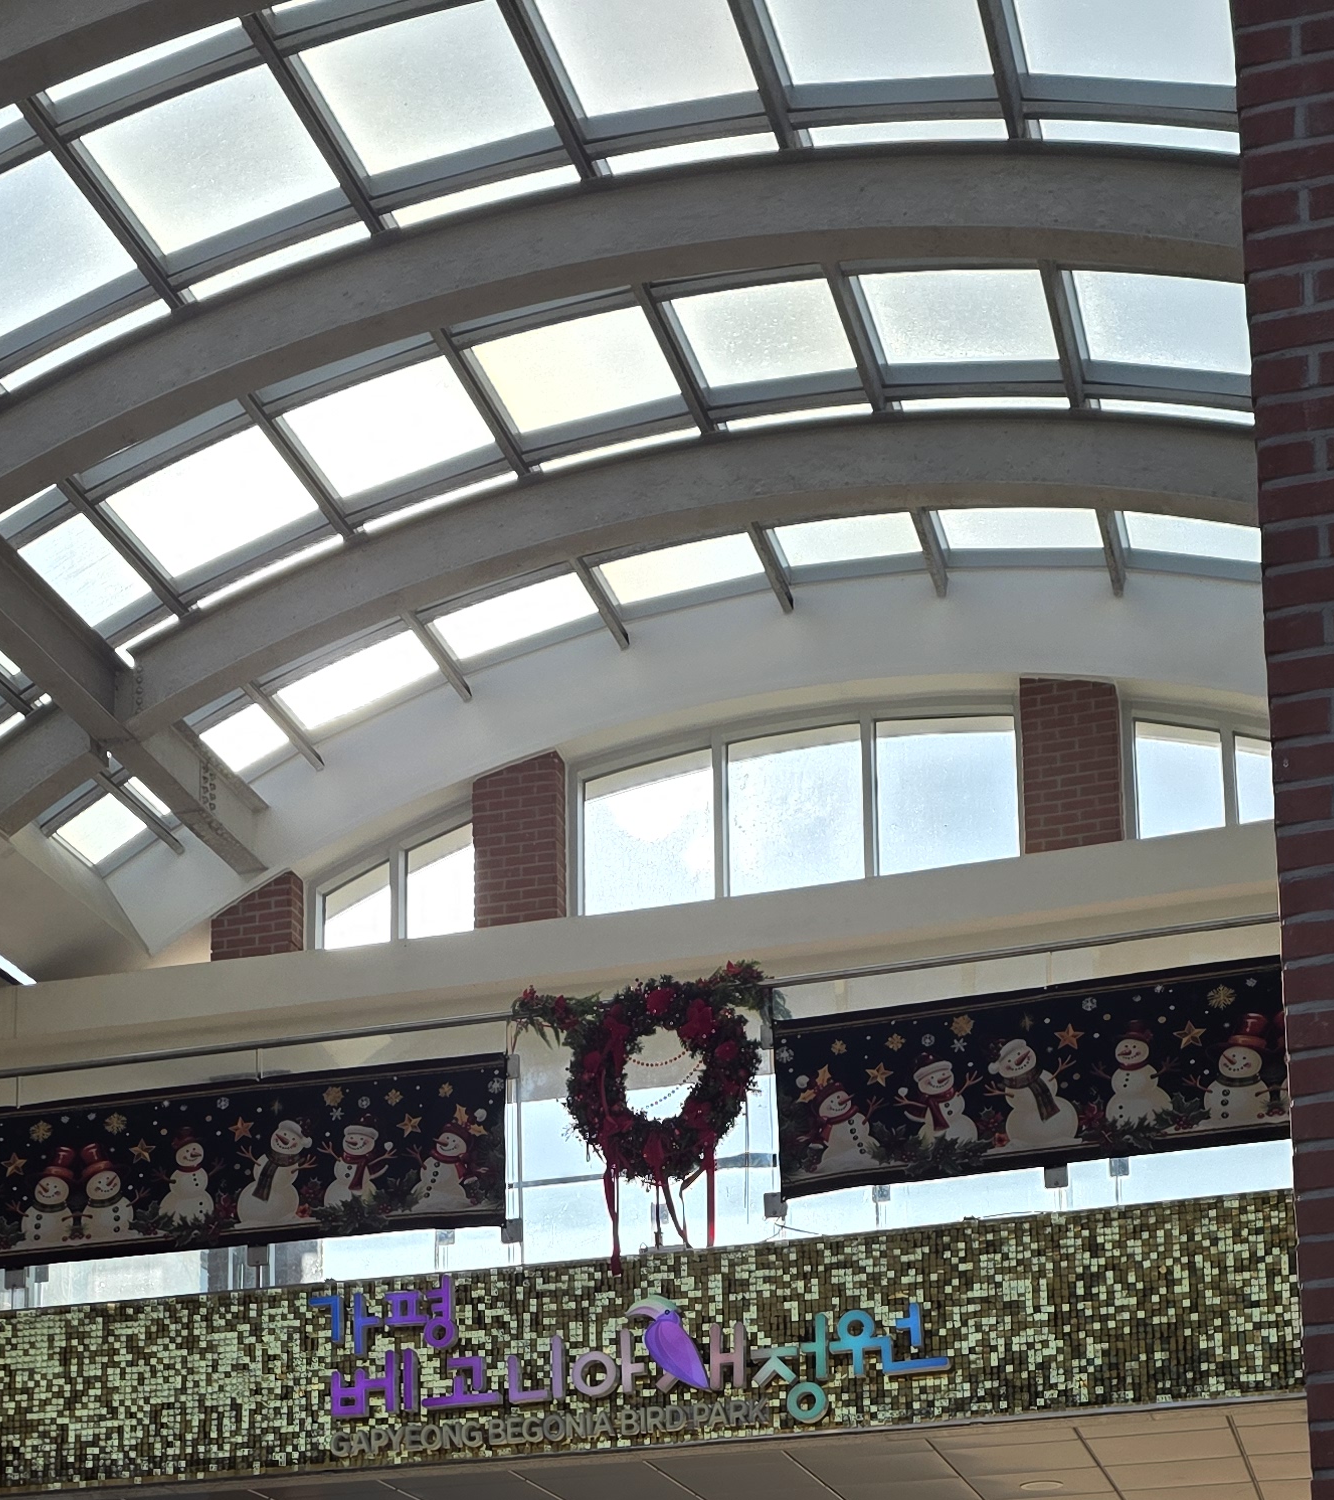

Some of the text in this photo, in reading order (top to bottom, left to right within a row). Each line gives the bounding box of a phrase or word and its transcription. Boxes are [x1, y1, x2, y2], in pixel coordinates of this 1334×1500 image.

[309, 1275, 458, 1355] 가평
[331, 1329, 648, 1418] 베고니아
[330, 1397, 770, 1458] GAPYEONG BEGONIA BIRD PARK
